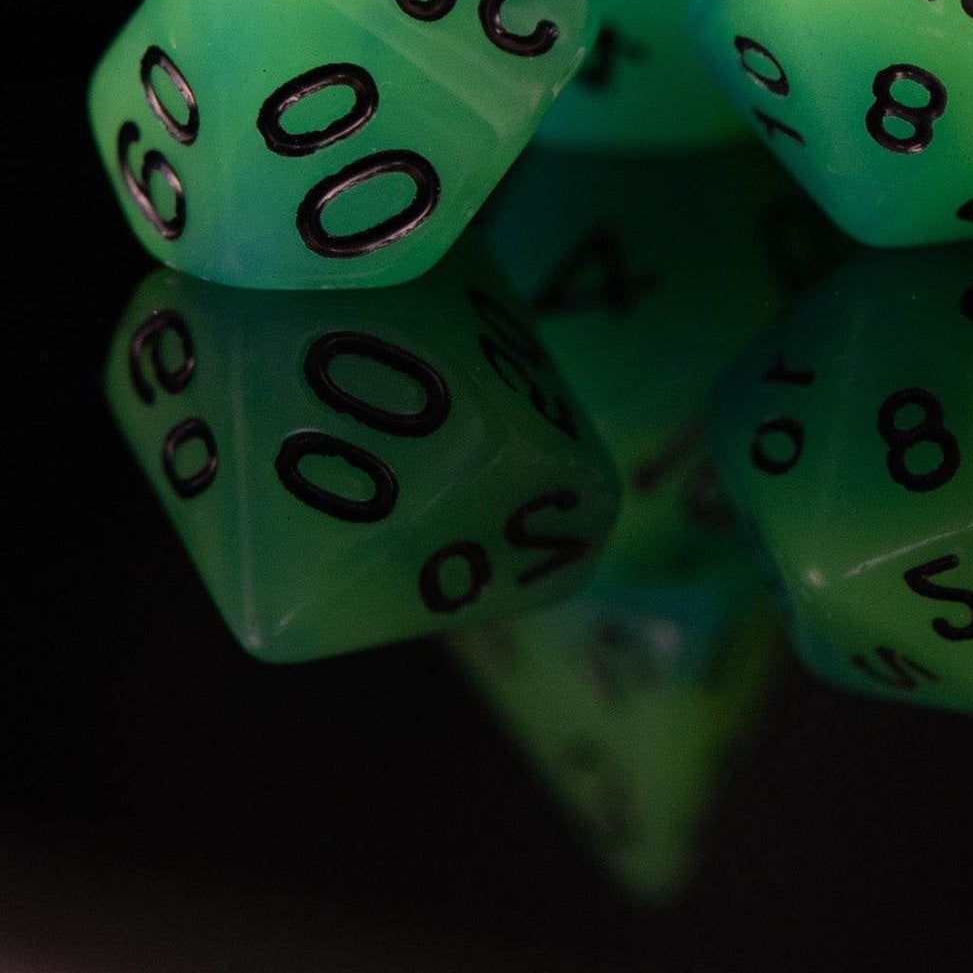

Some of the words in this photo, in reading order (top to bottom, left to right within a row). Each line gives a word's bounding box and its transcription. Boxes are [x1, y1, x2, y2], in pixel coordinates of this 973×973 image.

[116, 45, 200, 242] 60
[256, 61, 441, 259] 00
[864, 63, 948, 154] 8
